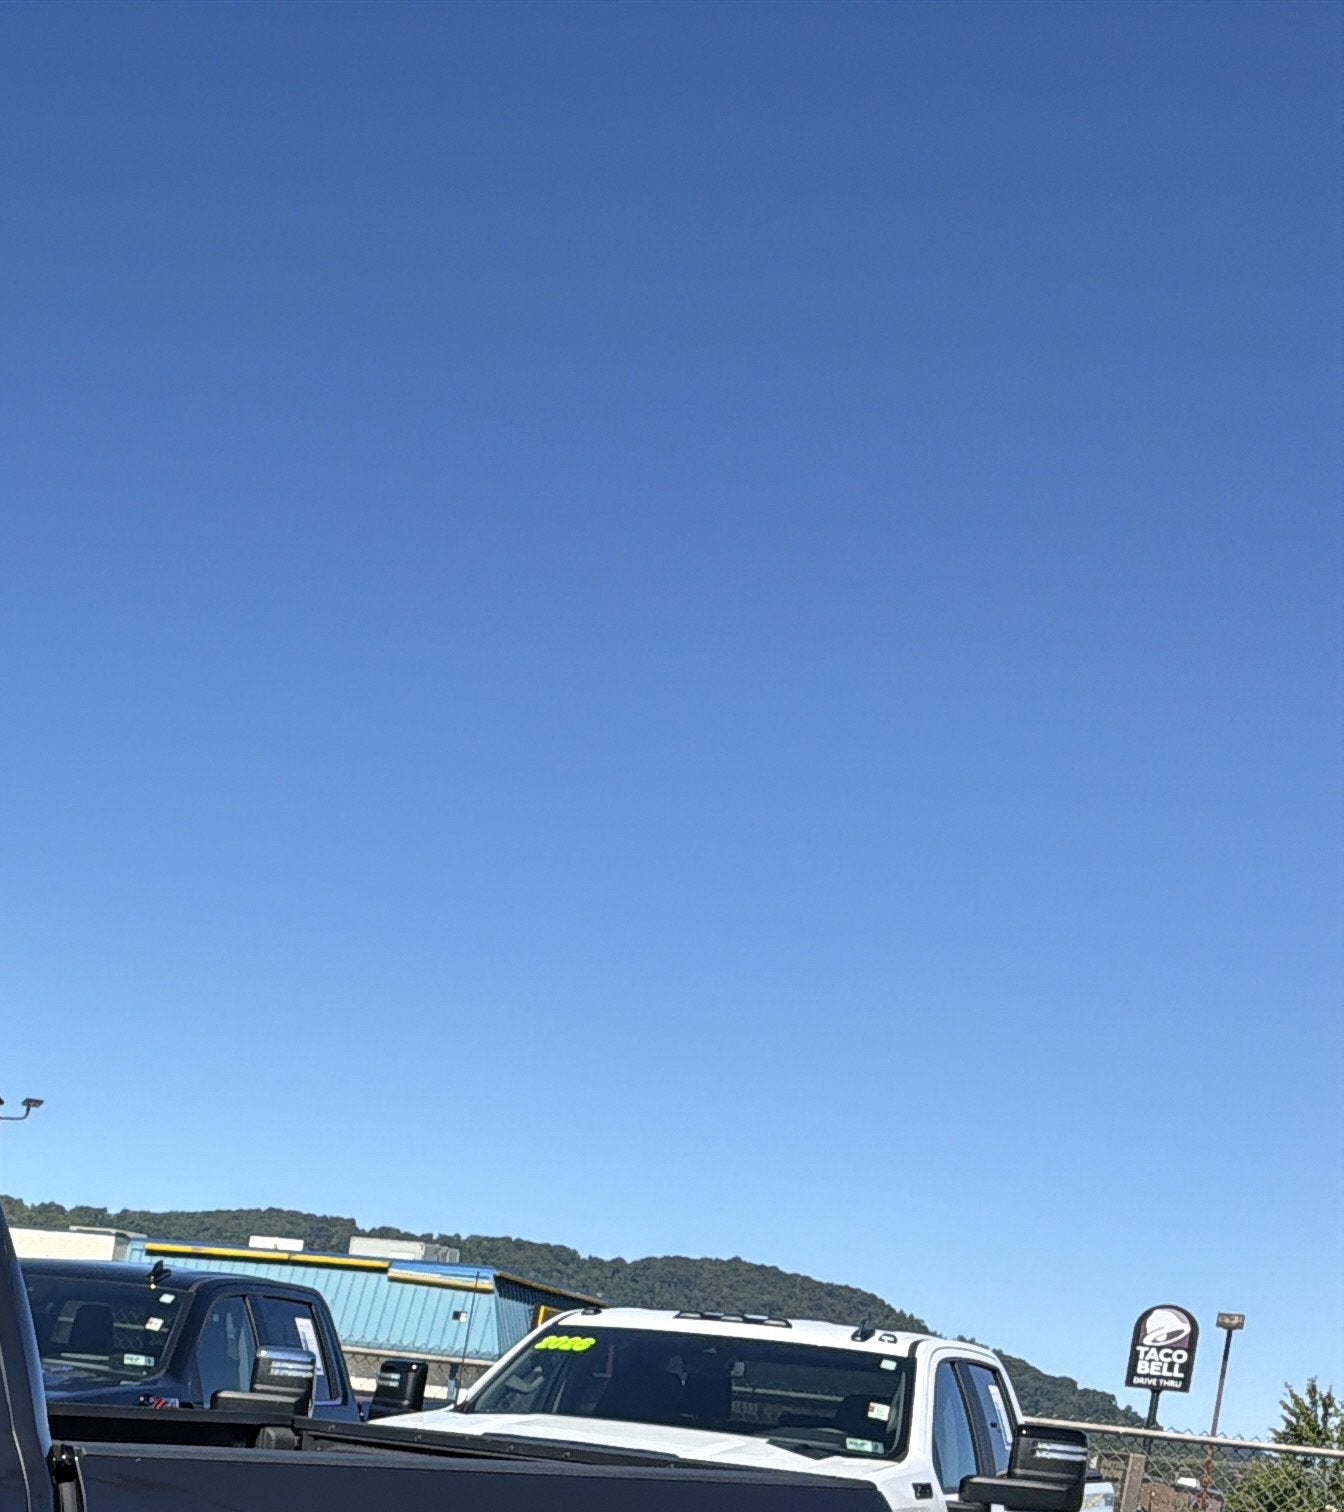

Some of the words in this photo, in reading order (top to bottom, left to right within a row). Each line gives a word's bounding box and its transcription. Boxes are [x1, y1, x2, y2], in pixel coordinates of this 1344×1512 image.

[1136, 1346, 1188, 1363] TACO
[1136, 1360, 1184, 1378] BELL
[1133, 1376, 1157, 1387] DRIVE
[1159, 1378, 1182, 1388] THRU
